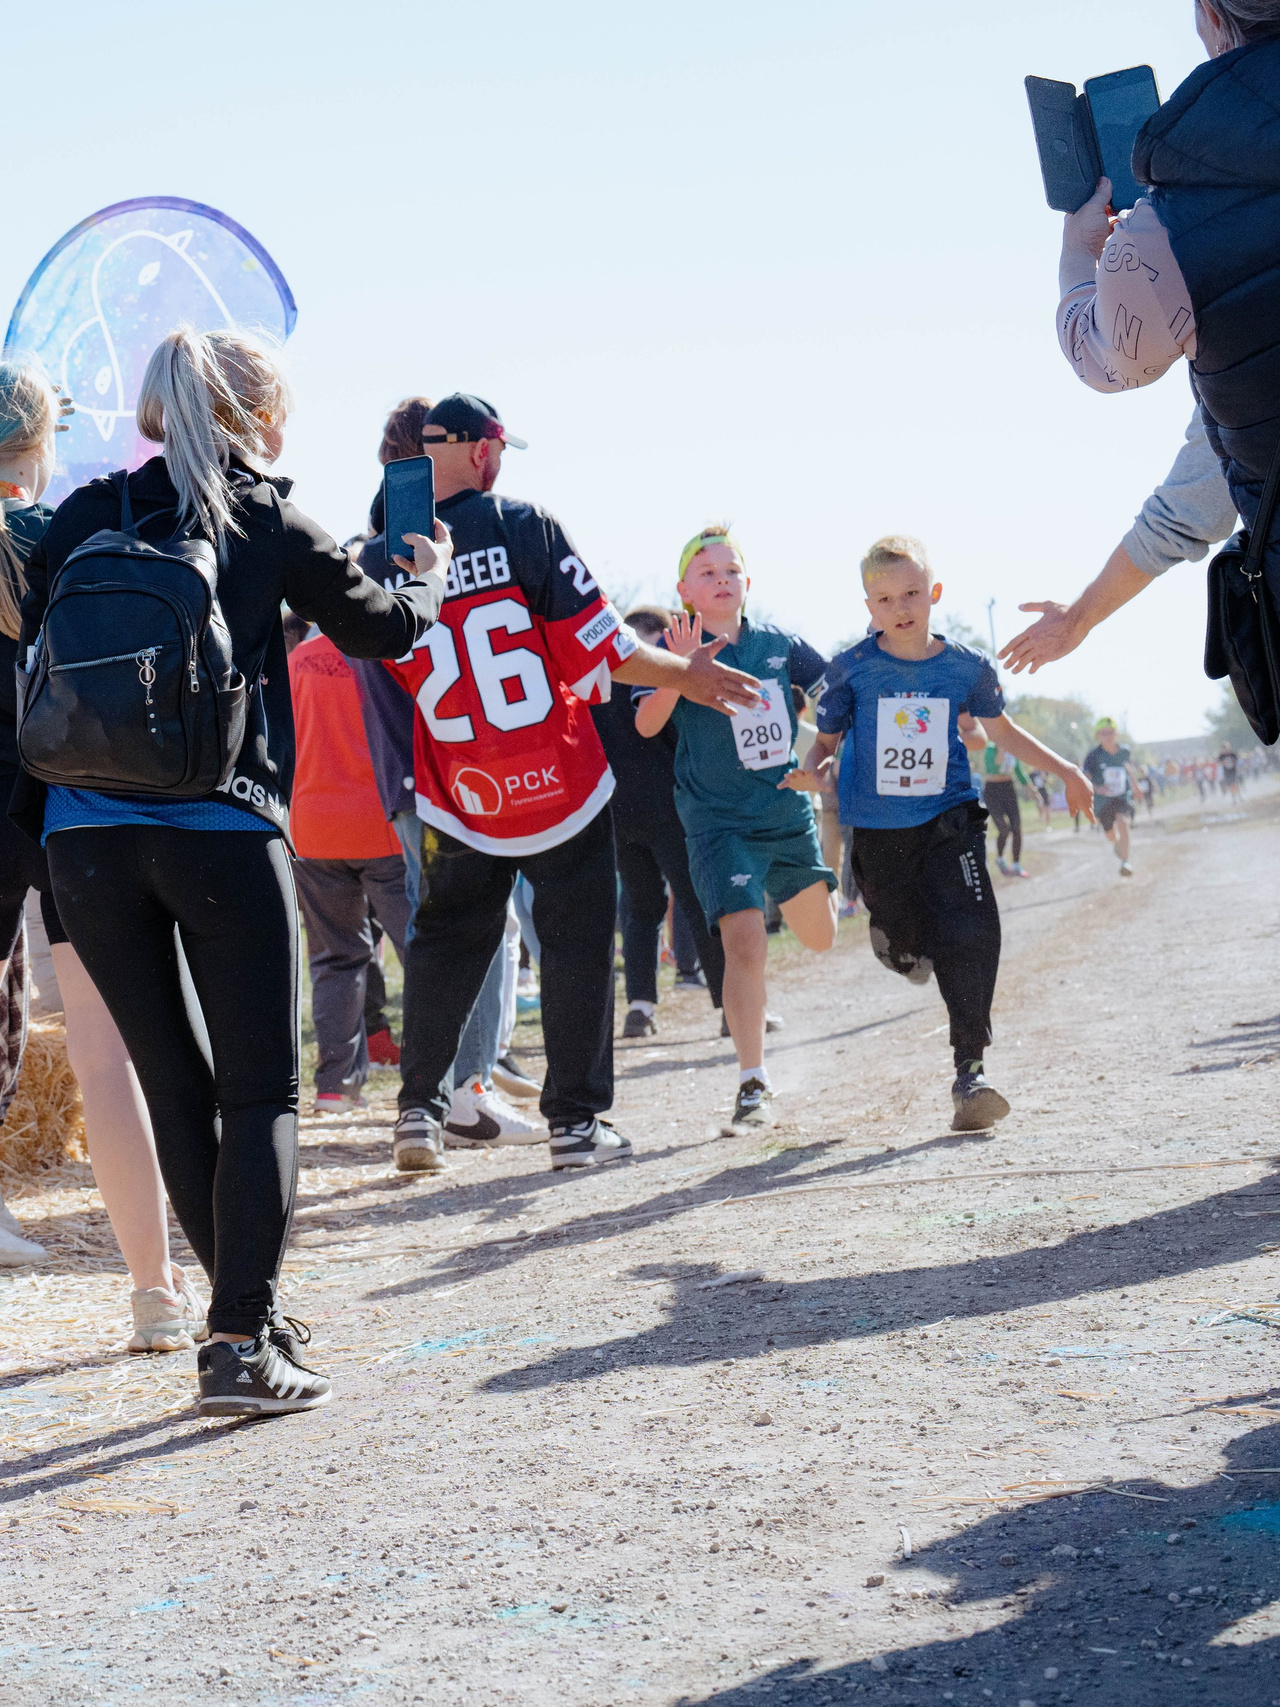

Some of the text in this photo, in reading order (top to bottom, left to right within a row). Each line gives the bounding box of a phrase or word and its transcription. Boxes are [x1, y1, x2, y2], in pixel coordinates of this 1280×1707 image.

[394, 597, 555, 743] 26
[740, 722, 782, 748] 280
[883, 747, 933, 770] 284
[504, 764, 560, 795] РСК
